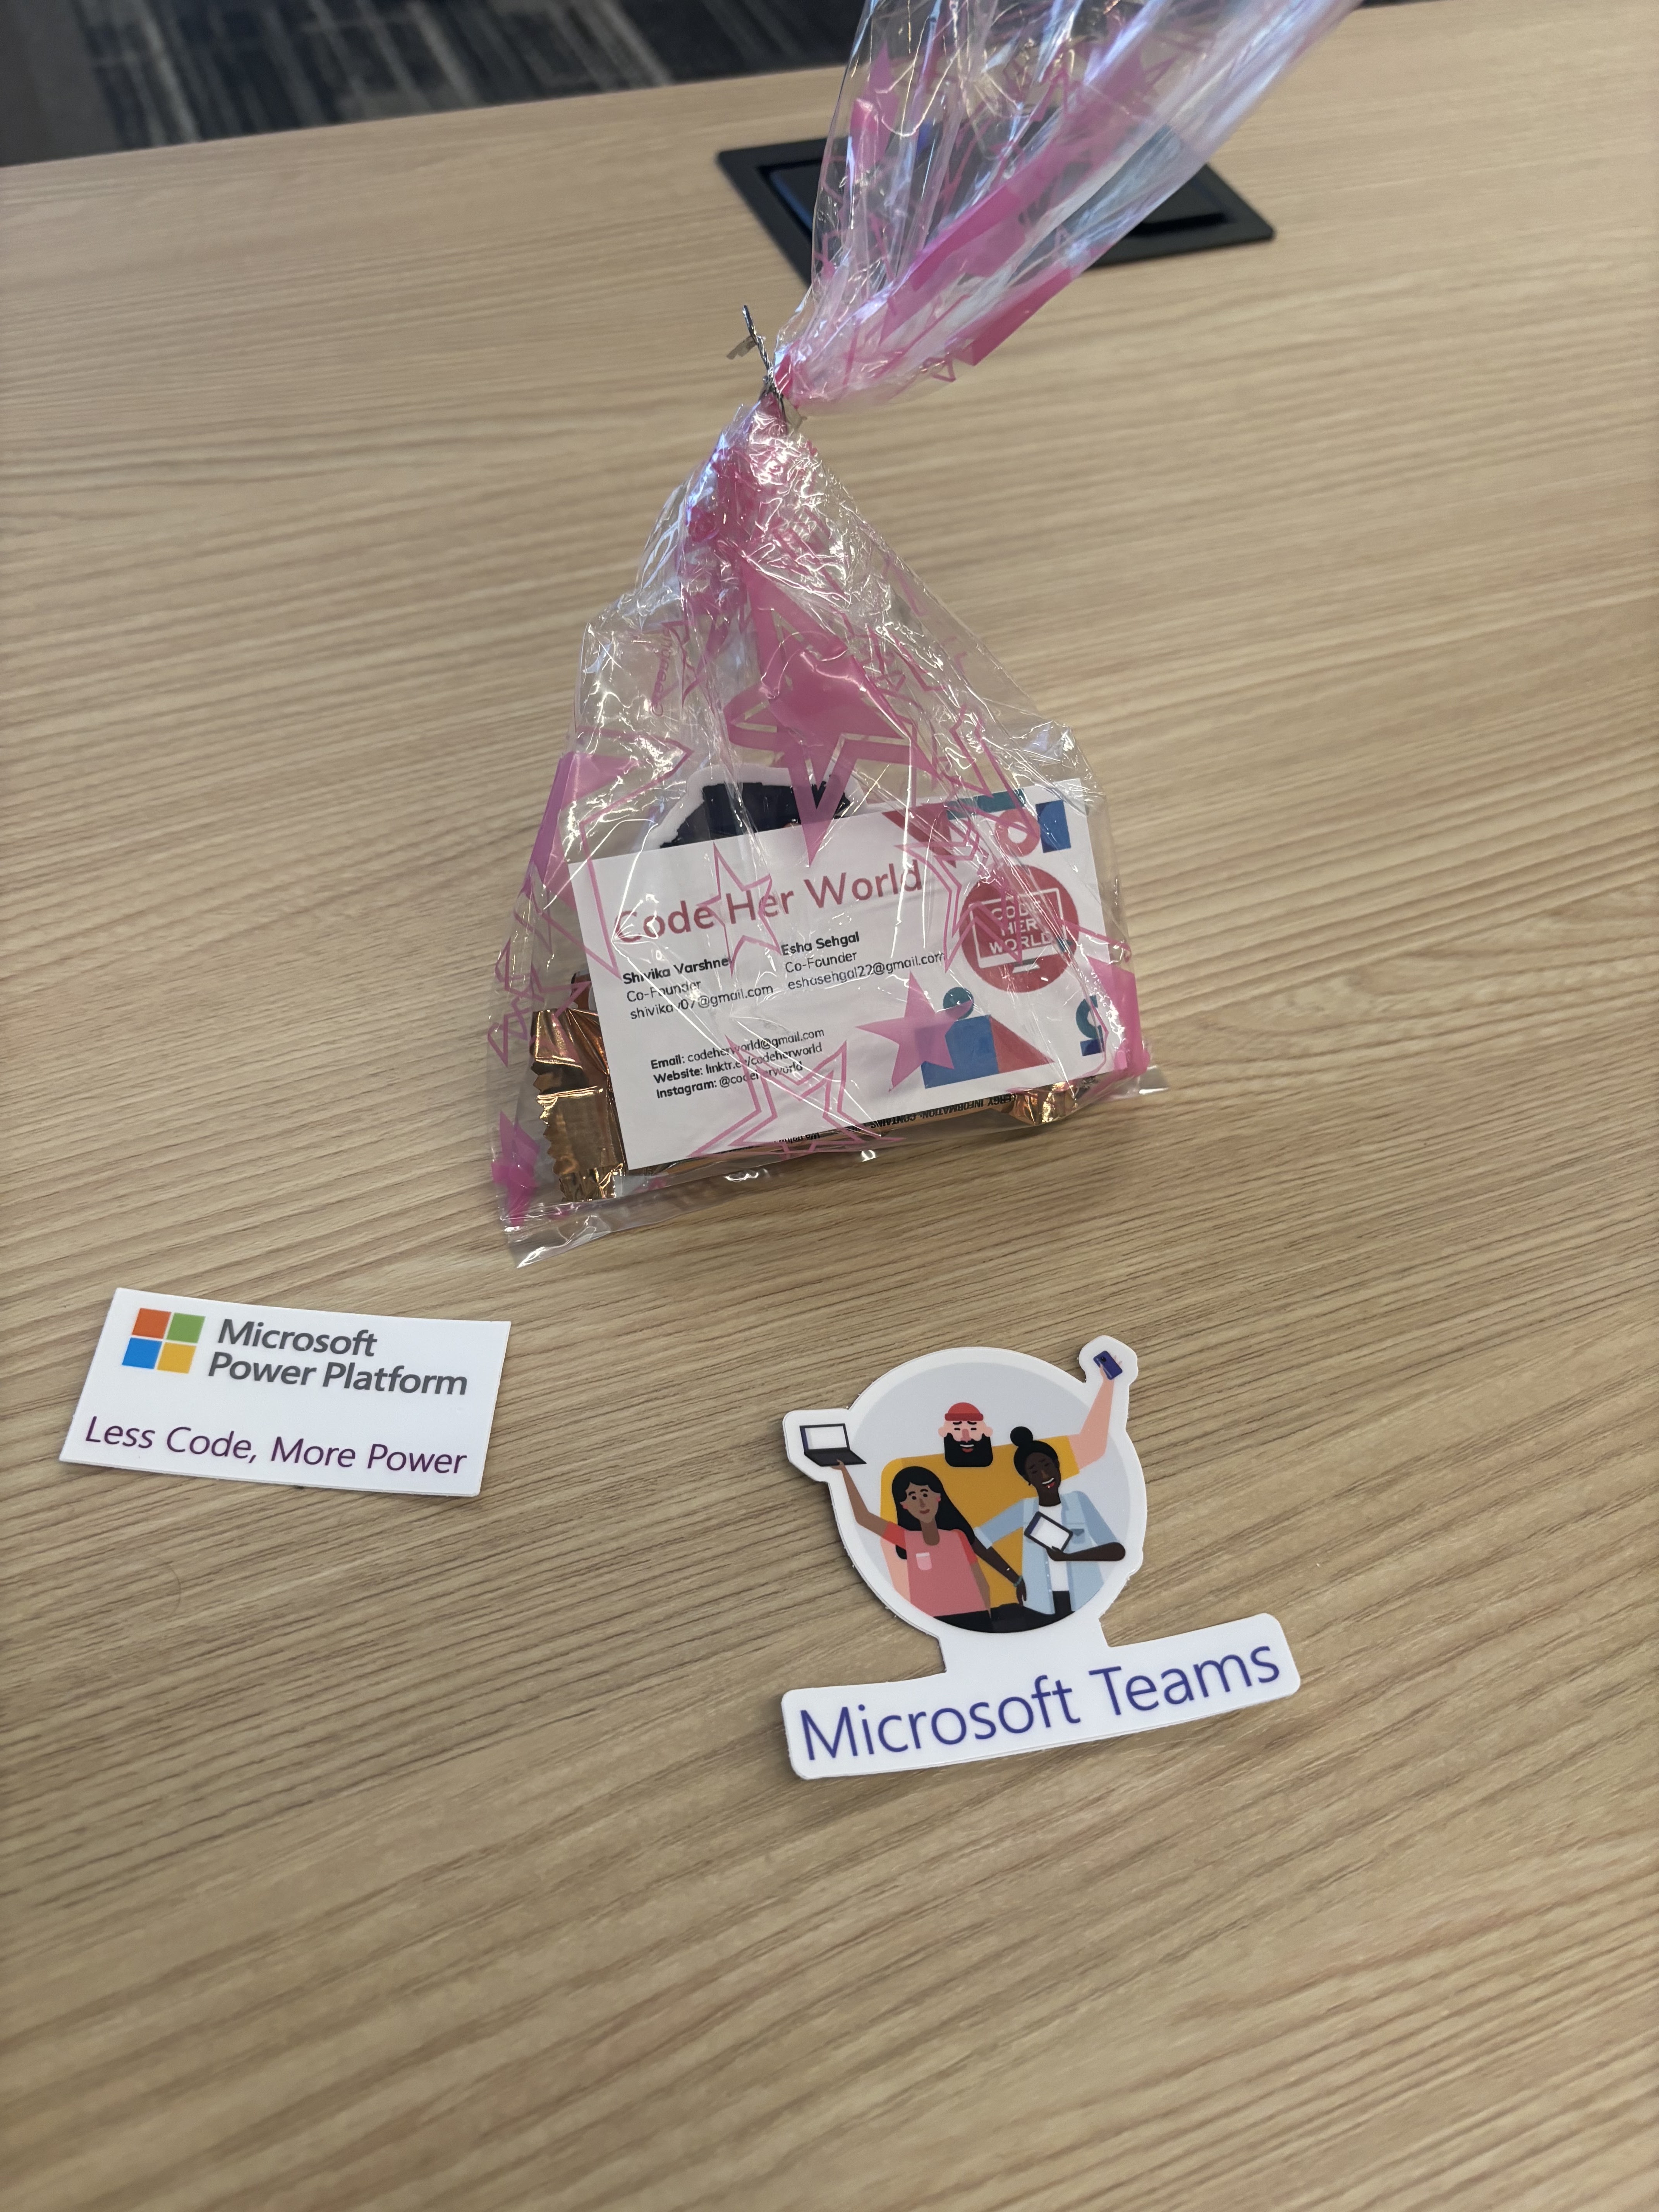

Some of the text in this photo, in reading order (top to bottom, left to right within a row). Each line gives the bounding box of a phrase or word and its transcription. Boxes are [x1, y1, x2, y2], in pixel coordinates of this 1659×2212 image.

[614, 860, 922, 943] Code Her World
[991, 902, 1041, 921] COD
[781, 931, 859, 956] Esha Sehgal
[989, 931, 1054, 954] WORLD
[785, 951, 857, 973] Co-Founder
[788, 952, 945, 990] eshasehgal22@gmail.com
[623, 968, 671, 984] Shivika
[627, 980, 701, 1002] Co-Founder
[650, 1029, 824, 1069] Email: codeherworld@gmail.com
[653, 1067, 703, 1084] Website:
[656, 1079, 717, 1098] Instagram:
[217, 1318, 377, 1358] Microsoft
[208, 1352, 468, 1396] Power Platform
[85, 1415, 468, 1474] Less Code, More Power
[799, 1645, 1281, 1761] Microsoft Teams
